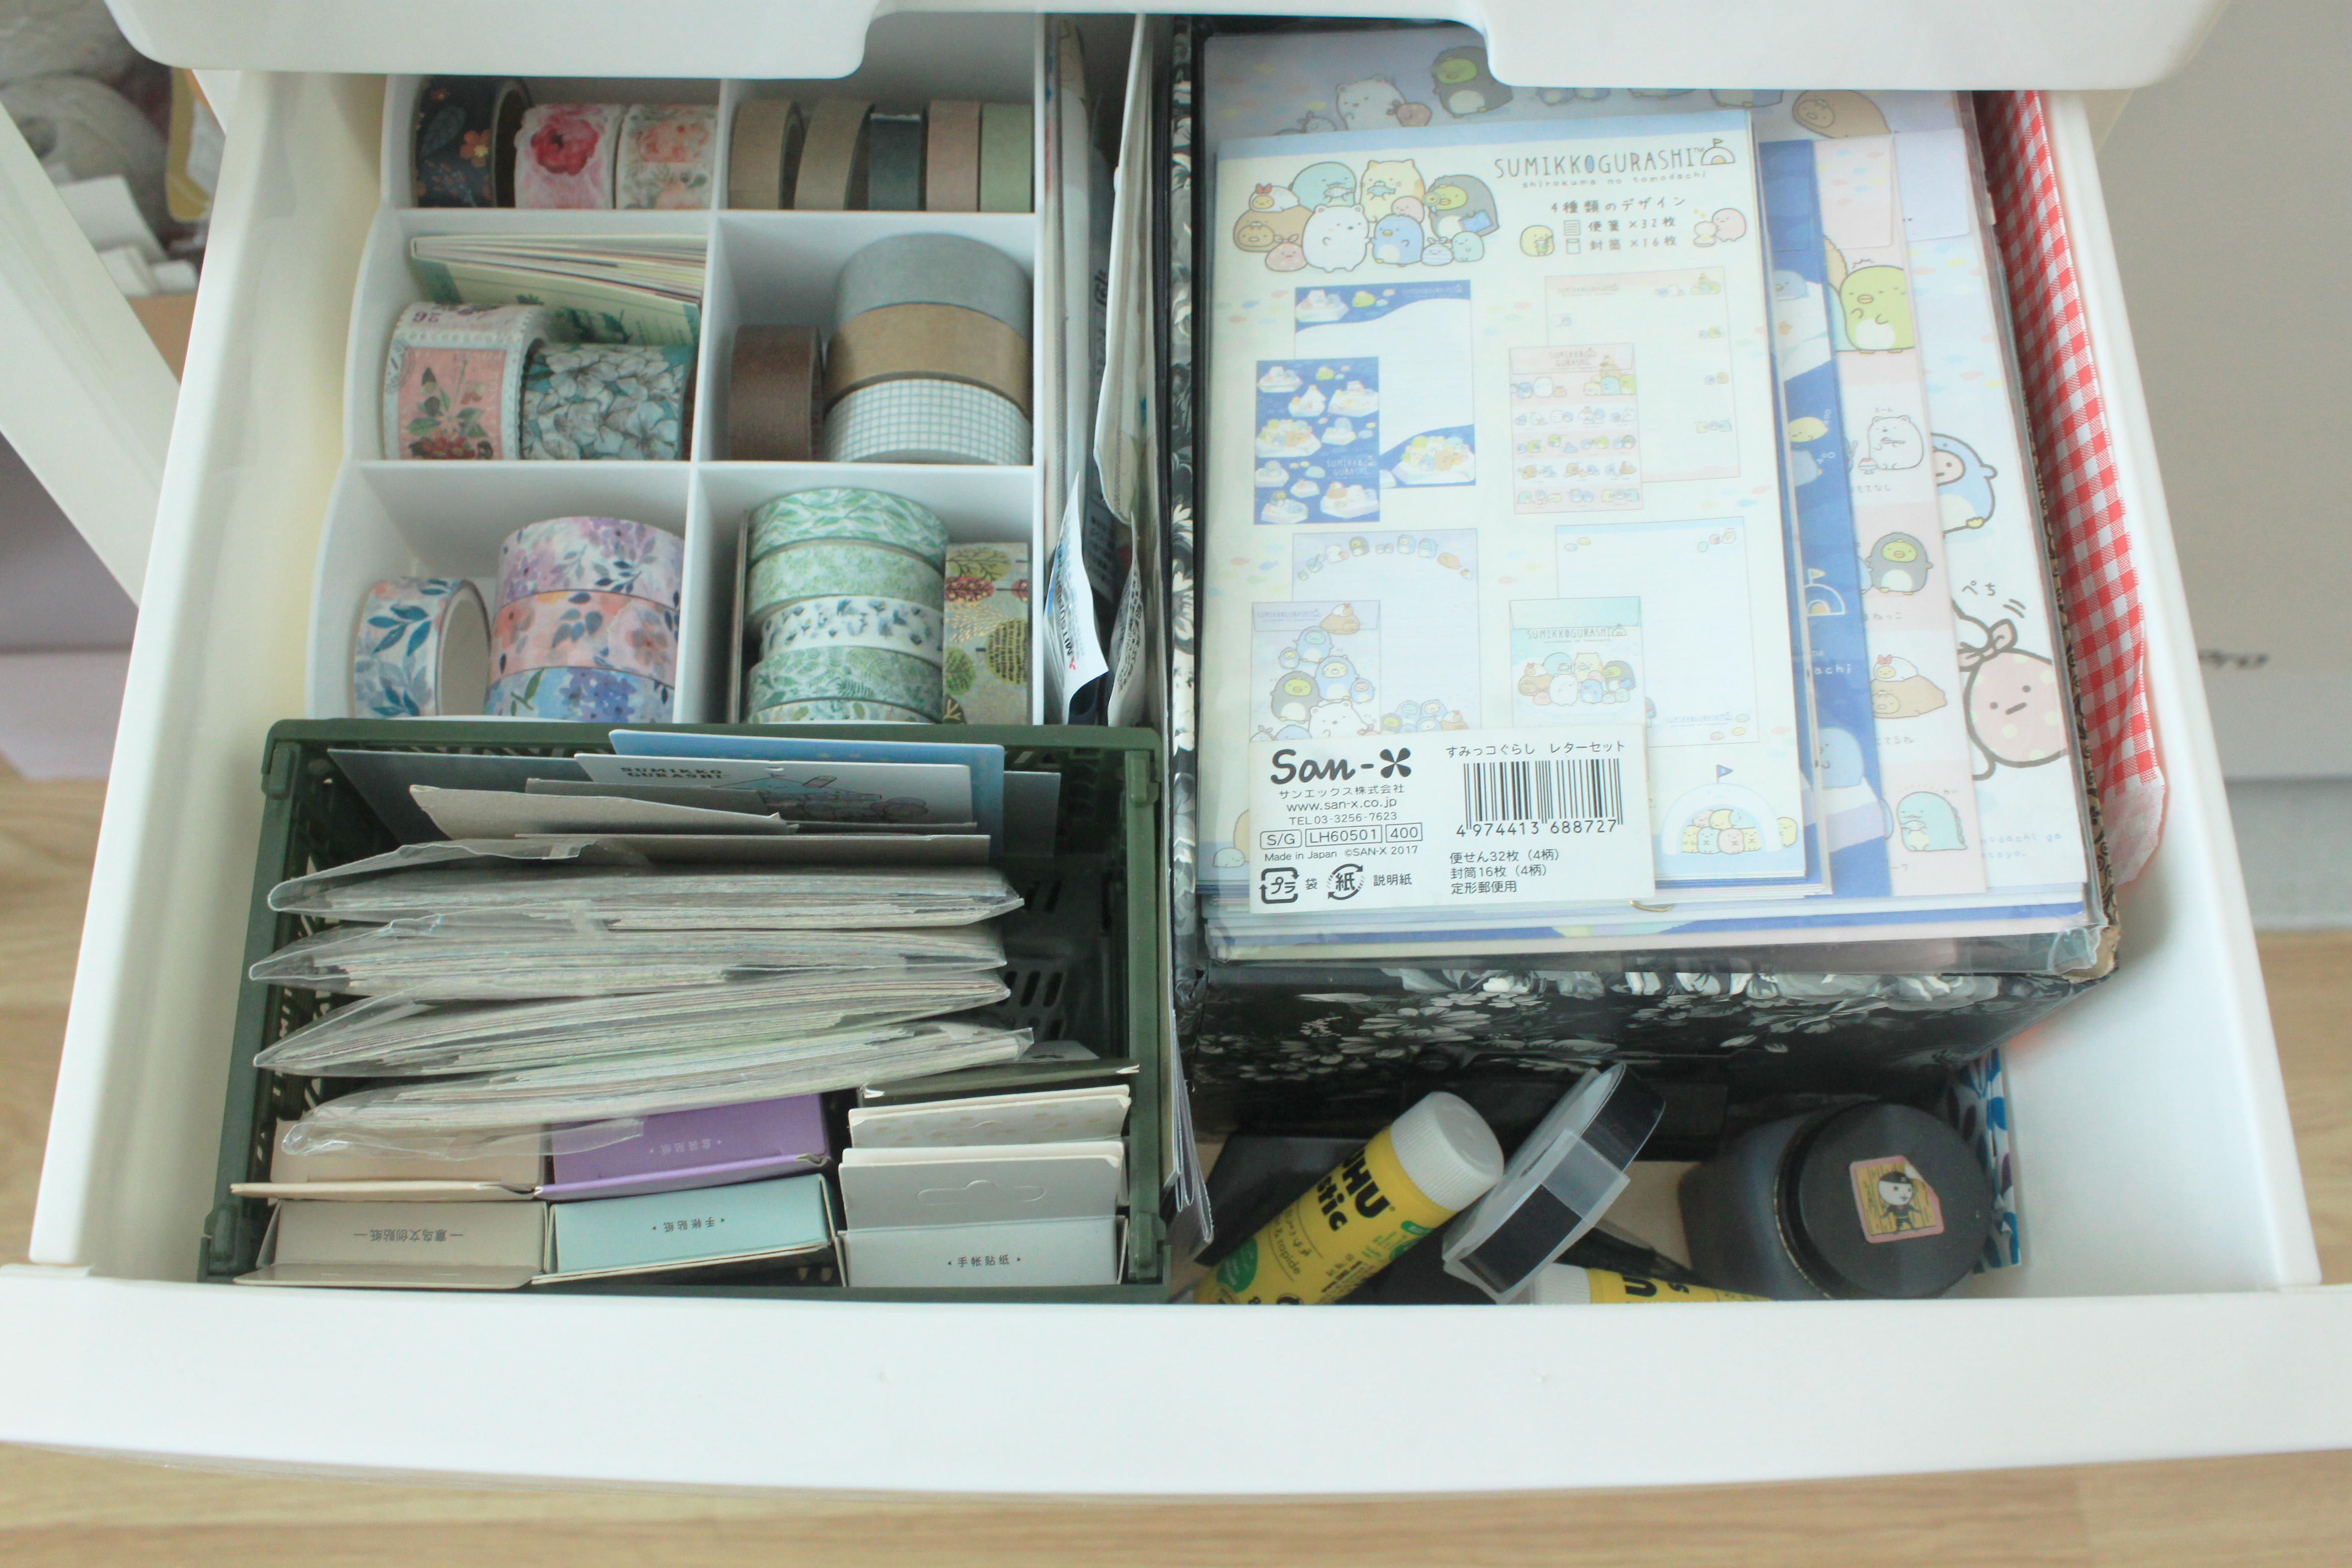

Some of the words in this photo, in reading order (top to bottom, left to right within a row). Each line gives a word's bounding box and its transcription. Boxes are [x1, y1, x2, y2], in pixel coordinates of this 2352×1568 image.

[1495, 148, 1694, 178] SUMIKKOGURASHI
[1523, 178, 1596, 188] shirokuma
[1633, 171, 1707, 183] tomodachi
[1446, 743, 1535, 758] すみっコぐらし
[1550, 740, 1625, 754] レターセット
[1279, 784, 1405, 799] サンエックス株式会社
[1286, 796, 1397, 812] www.san-x.co.jp
[1267, 833, 1295, 846] S/G
[1310, 828, 1377, 844] LH60501
[1390, 826, 1419, 840] 400
[1265, 850, 1292, 862] Made
[1295, 851, 1304, 860] in
[1307, 850, 1337, 860] Japan
[1391, 845, 1418, 855] 2017
[1305, 877, 1319, 890] 袋
[1373, 873, 1413, 887] 説明紙
[1451, 880, 1518, 895] 定形郵便用
[663, 1216, 715, 1233] 手帐贴纸
[958, 1254, 1010, 1268] 手帐贴纸
